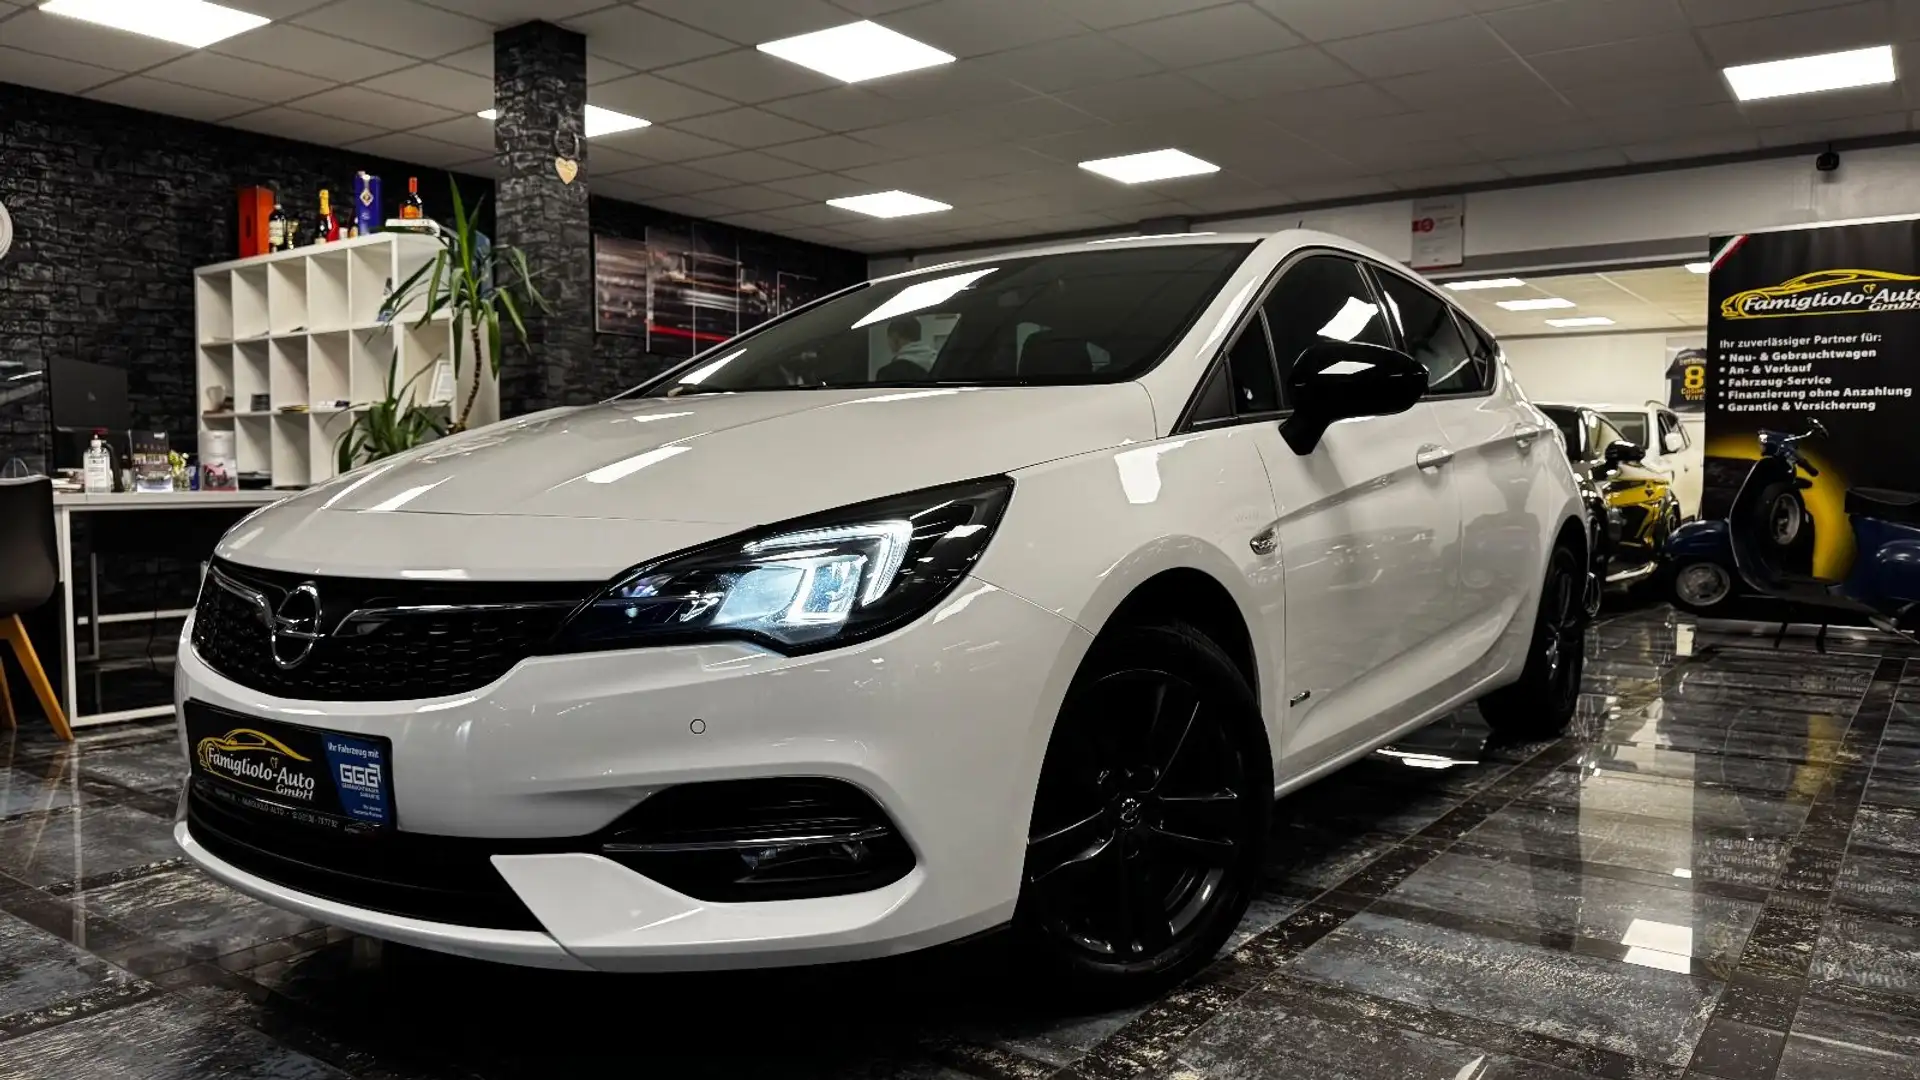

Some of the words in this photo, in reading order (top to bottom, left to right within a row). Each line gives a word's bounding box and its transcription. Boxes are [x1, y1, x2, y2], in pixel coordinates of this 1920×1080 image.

[1720, 339, 1735, 348] Ihr
[1738, 336, 1811, 348] zuverlässiger
[1814, 335, 1858, 345] Partner
[1861, 333, 1882, 342] für:
[1729, 353, 1757, 362] Neu-
[1760, 352, 1769, 361] &
[1772, 350, 1877, 361] Gebrauchtwagen
[1728, 366, 1750, 375] An-
[1752, 364, 1761, 374] &
[1764, 363, 1812, 374] Verkauf
[1684, 366, 1705, 389] 8
[1728, 376, 1832, 388] Fahrzeug-Service
[1728, 389, 1806, 400] Finanzierung
[1809, 388, 1840, 397] ohne
[1843, 387, 1912, 397] Anzahlung
[1727, 402, 1779, 411] Garantie
[1782, 401, 1791, 411] &
[1794, 400, 1876, 411] Versicherung
[338, 744, 367, 759] Fahrzeug
[209, 747, 315, 790] Famigliolo-Auto
[275, 783, 313, 800] GmbH
